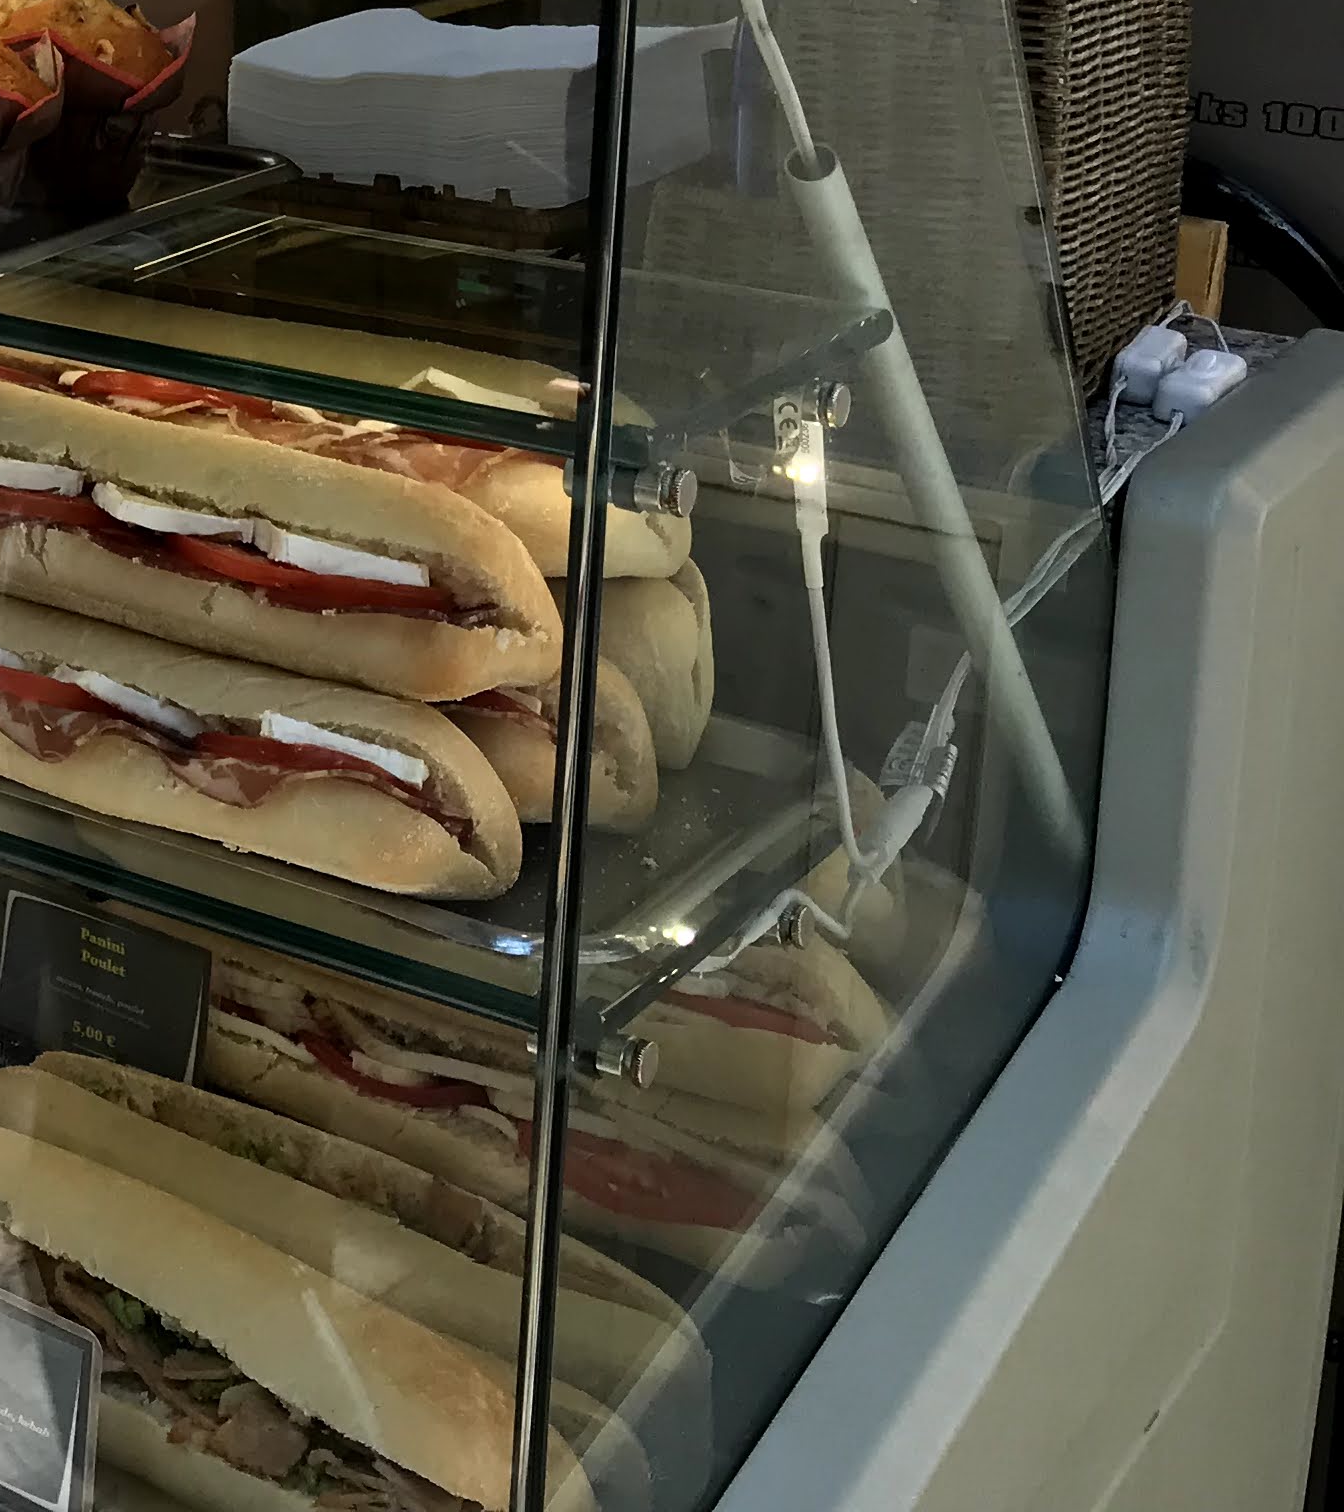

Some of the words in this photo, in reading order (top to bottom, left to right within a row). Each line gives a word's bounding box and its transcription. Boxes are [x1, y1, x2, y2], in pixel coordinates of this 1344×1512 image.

[80, 926, 127, 956] Panini
[80, 948, 127, 978] Poulet
[72, 1019, 104, 1043] 5,00
[17, 1413, 51, 1439] kebab
